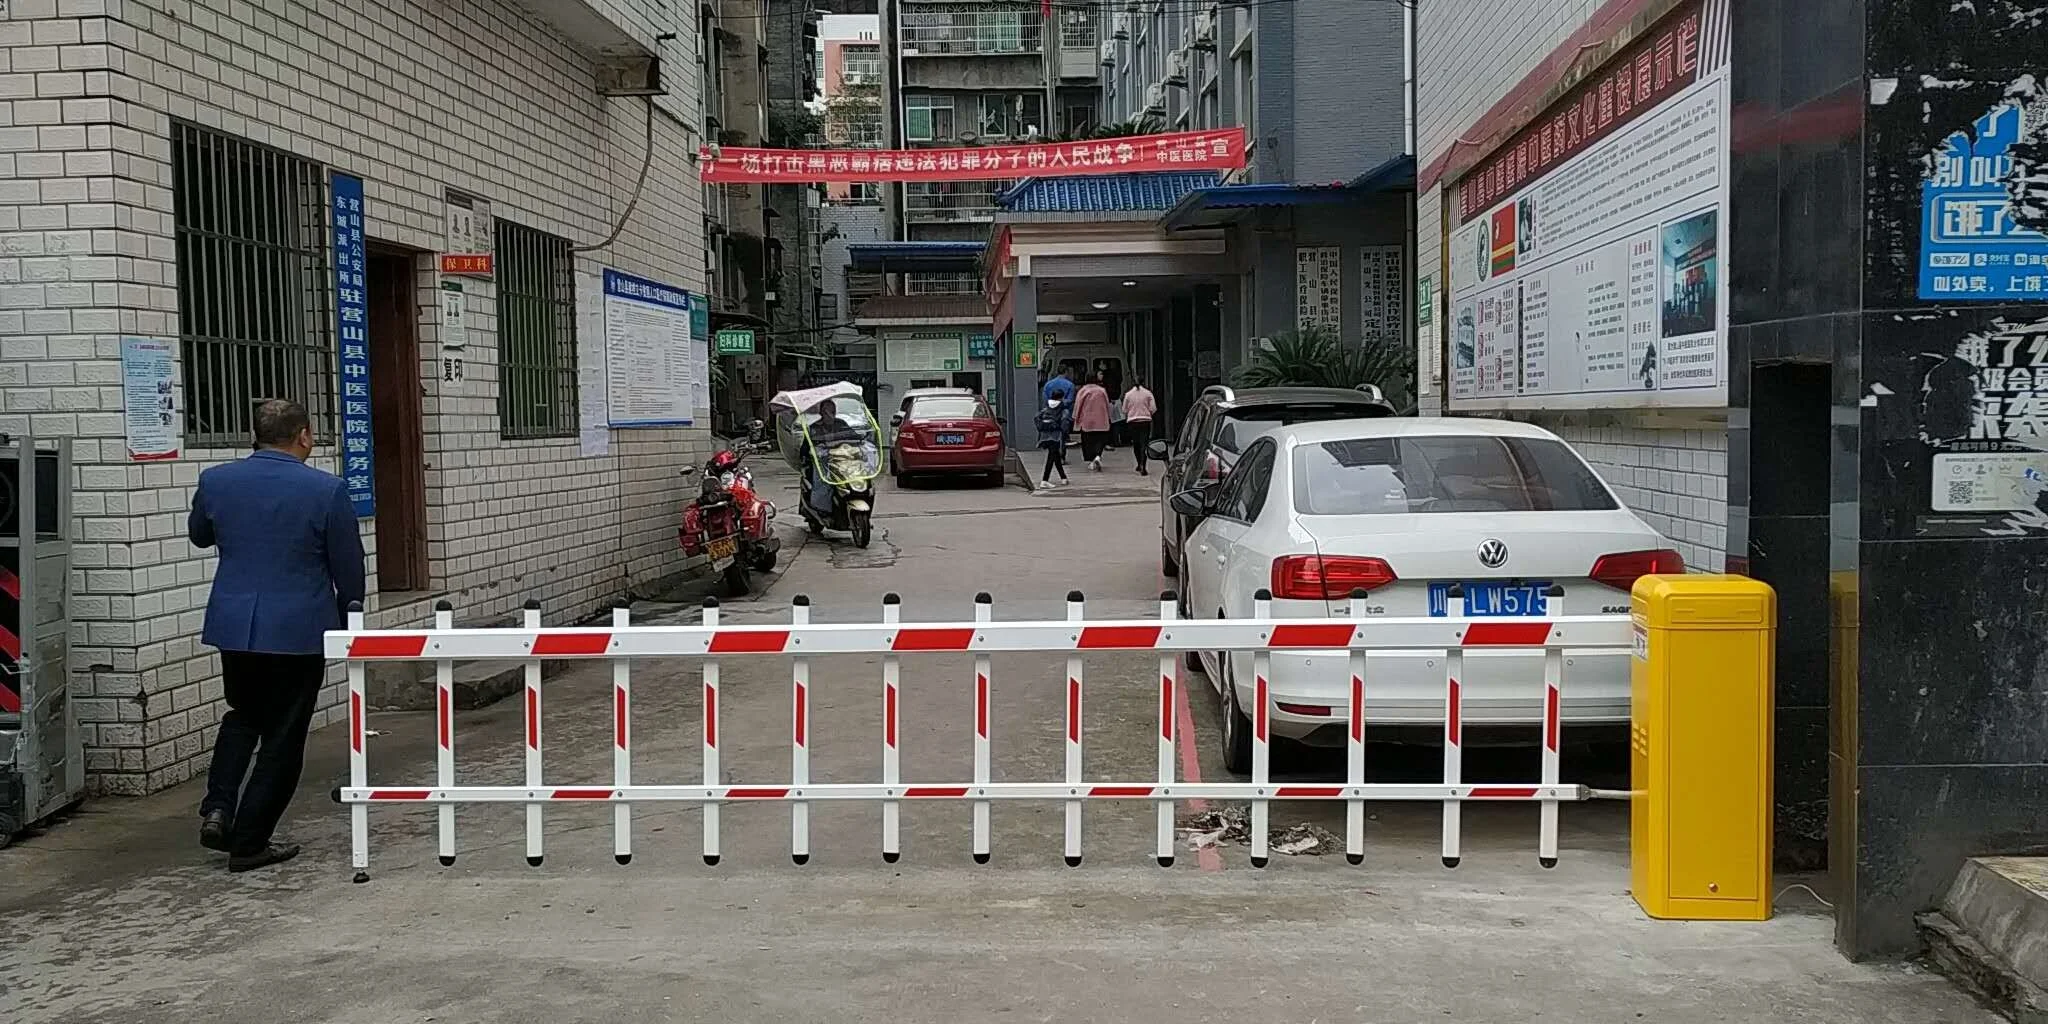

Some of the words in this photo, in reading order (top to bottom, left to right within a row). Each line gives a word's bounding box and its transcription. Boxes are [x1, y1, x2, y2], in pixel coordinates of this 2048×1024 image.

[1156, 148, 1208, 163] 中医医院
[1210, 137, 1229, 157] 宣
[336, 195, 350, 285] 东城派出所
[349, 198, 363, 287] 营山县公安局
[446, 257, 488, 271] 保卫科
[443, 356, 463, 382] 复印
[340, 287, 371, 490] 驻营山县中医医院警务室
